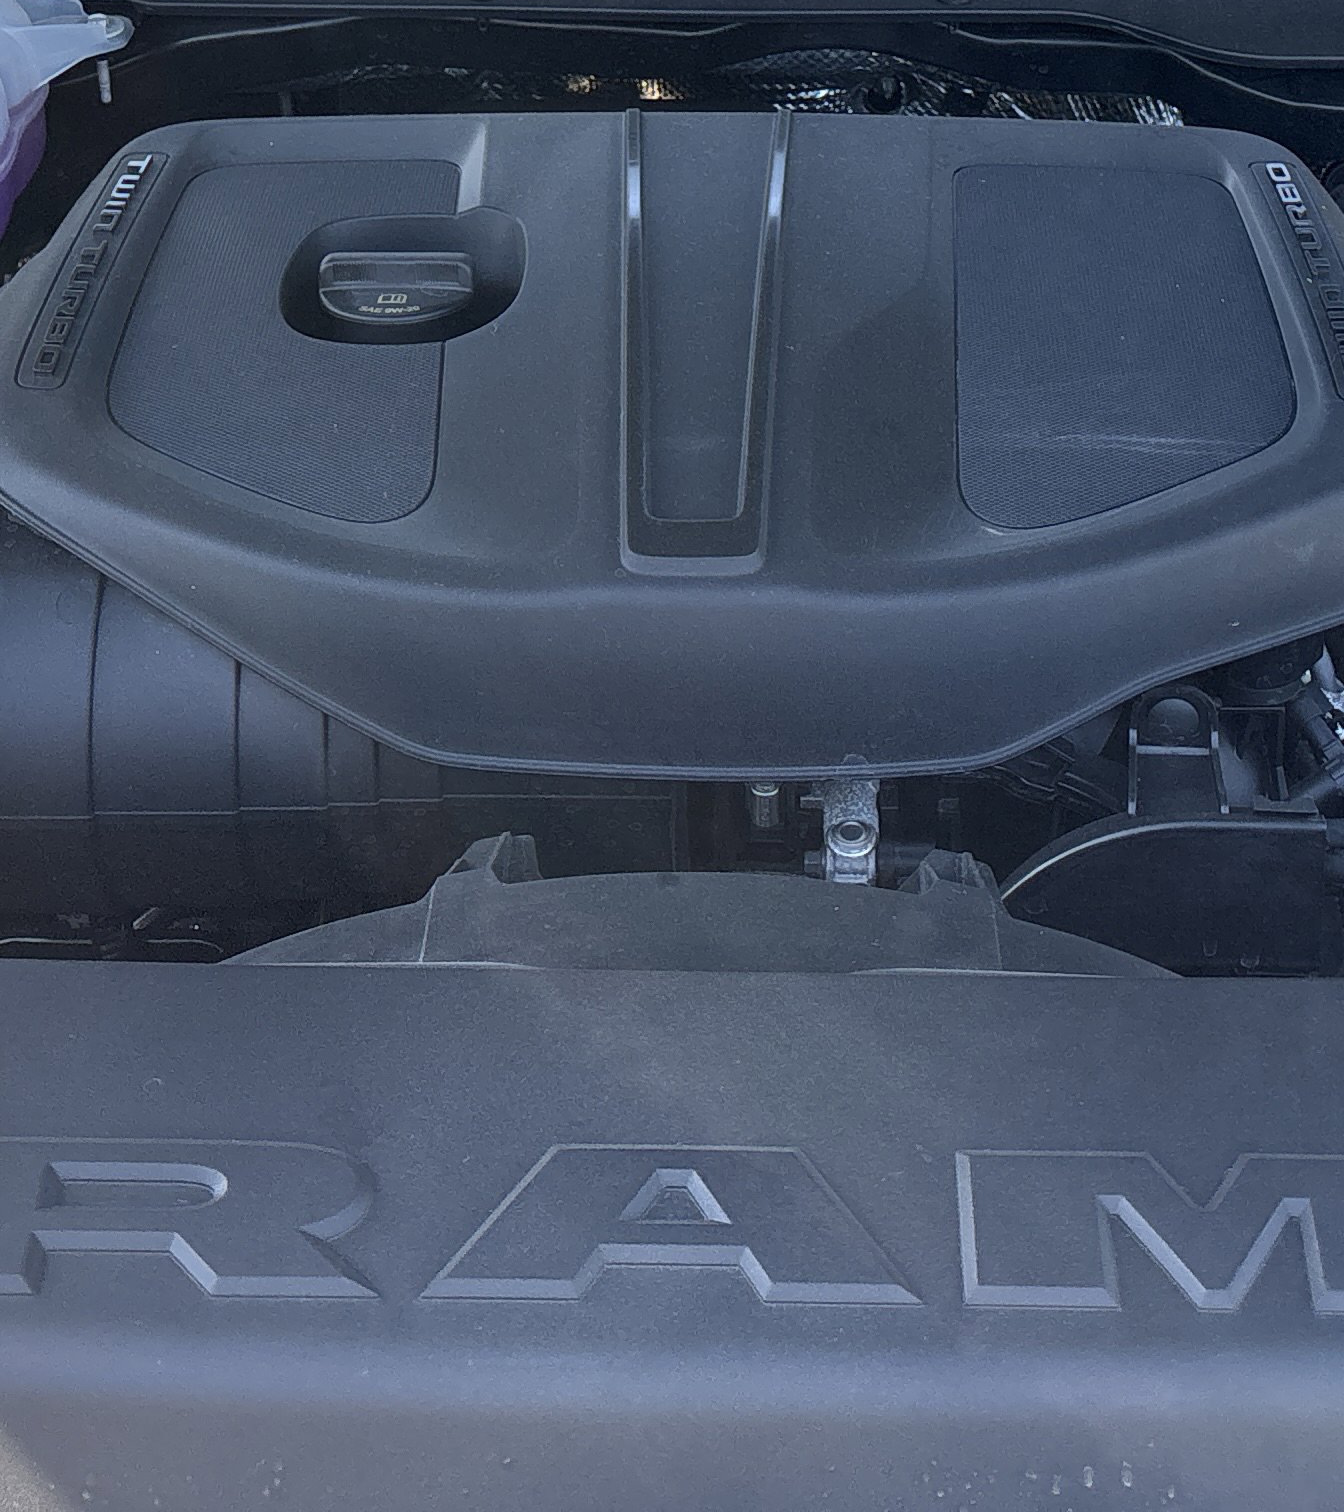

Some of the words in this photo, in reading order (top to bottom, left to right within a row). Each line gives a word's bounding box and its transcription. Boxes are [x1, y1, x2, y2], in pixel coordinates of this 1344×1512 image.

[1265, 162, 1331, 276] TURBO
[33, 239, 107, 376] TURBO
[358, 305, 384, 314] SAE
